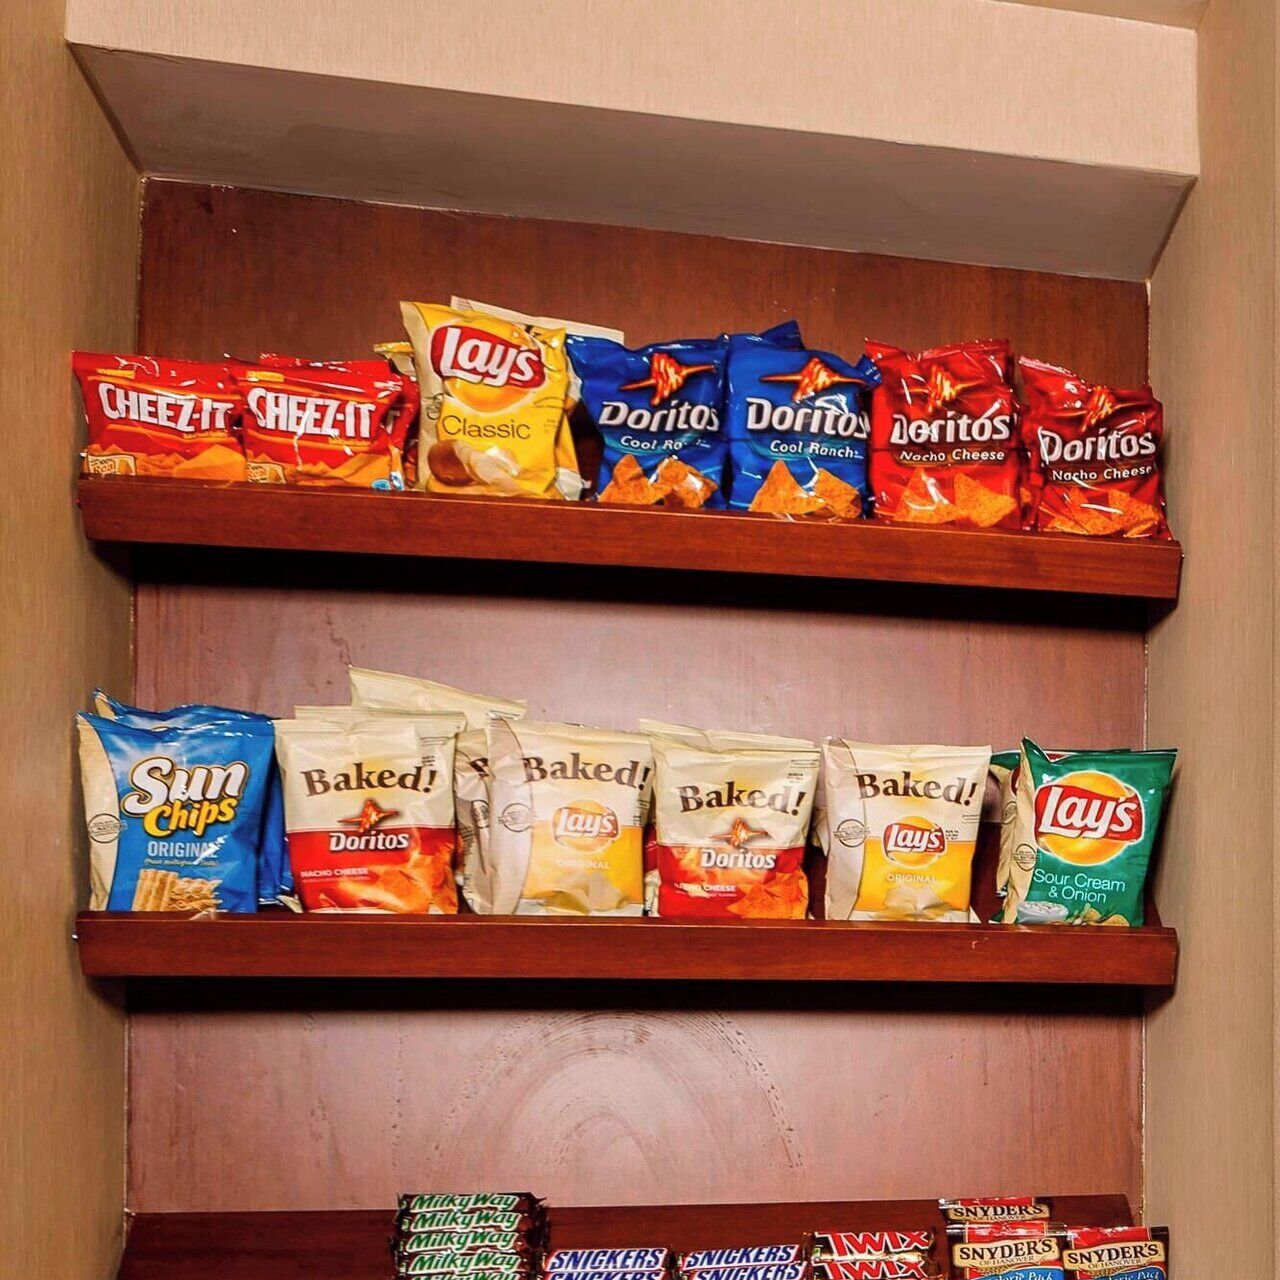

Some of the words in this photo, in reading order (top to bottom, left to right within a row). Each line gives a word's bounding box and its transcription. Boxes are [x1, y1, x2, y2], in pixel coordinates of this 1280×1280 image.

[440, 327, 539, 388] Lay's
[98, 383, 234, 432] CHEEZ-IT
[247, 387, 375, 438] CHEEZ-IT
[599, 401, 719, 432] Doritos
[746, 395, 869, 438] Doritos
[442, 415, 530, 439] Classic
[891, 410, 1011, 444] Doritos
[621, 436, 656, 450] Cool
[771, 440, 803, 455] Cool
[900, 449, 946, 462] Nacho
[952, 448, 1004, 462] Cheese
[1040, 427, 1156, 465] Doritos
[1052, 468, 1097, 481] Nacho
[1104, 466, 1151, 480] Cheese
[301, 764, 436, 797] Baked!
[522, 754, 650, 791] Baked!
[123, 758, 247, 817] Sun
[679, 781, 806, 816] Baked!
[857, 771, 977, 806] Baked!
[143, 796, 237, 837] Chips
[1038, 787, 1139, 839] Lay's
[330, 831, 409, 851] Doritos
[887, 824, 943, 855] Lay's
[701, 848, 776, 870] Doritos
[1033, 868, 1070, 888] Sour
[1074, 874, 1125, 892] Cream
[1048, 887, 1059, 899] &
[1062, 885, 1106, 903] Onion
[954, 1205, 1043, 1217] SNYDER'S
[686, 1246, 792, 1267] SNICKERS
[816, 1231, 930, 1256] TWIX
[959, 1238, 1053, 1260] SNYDER'S
[1068, 1244, 1159, 1263] SNYDER'S
[550, 1249, 665, 1270] SNICKERS
